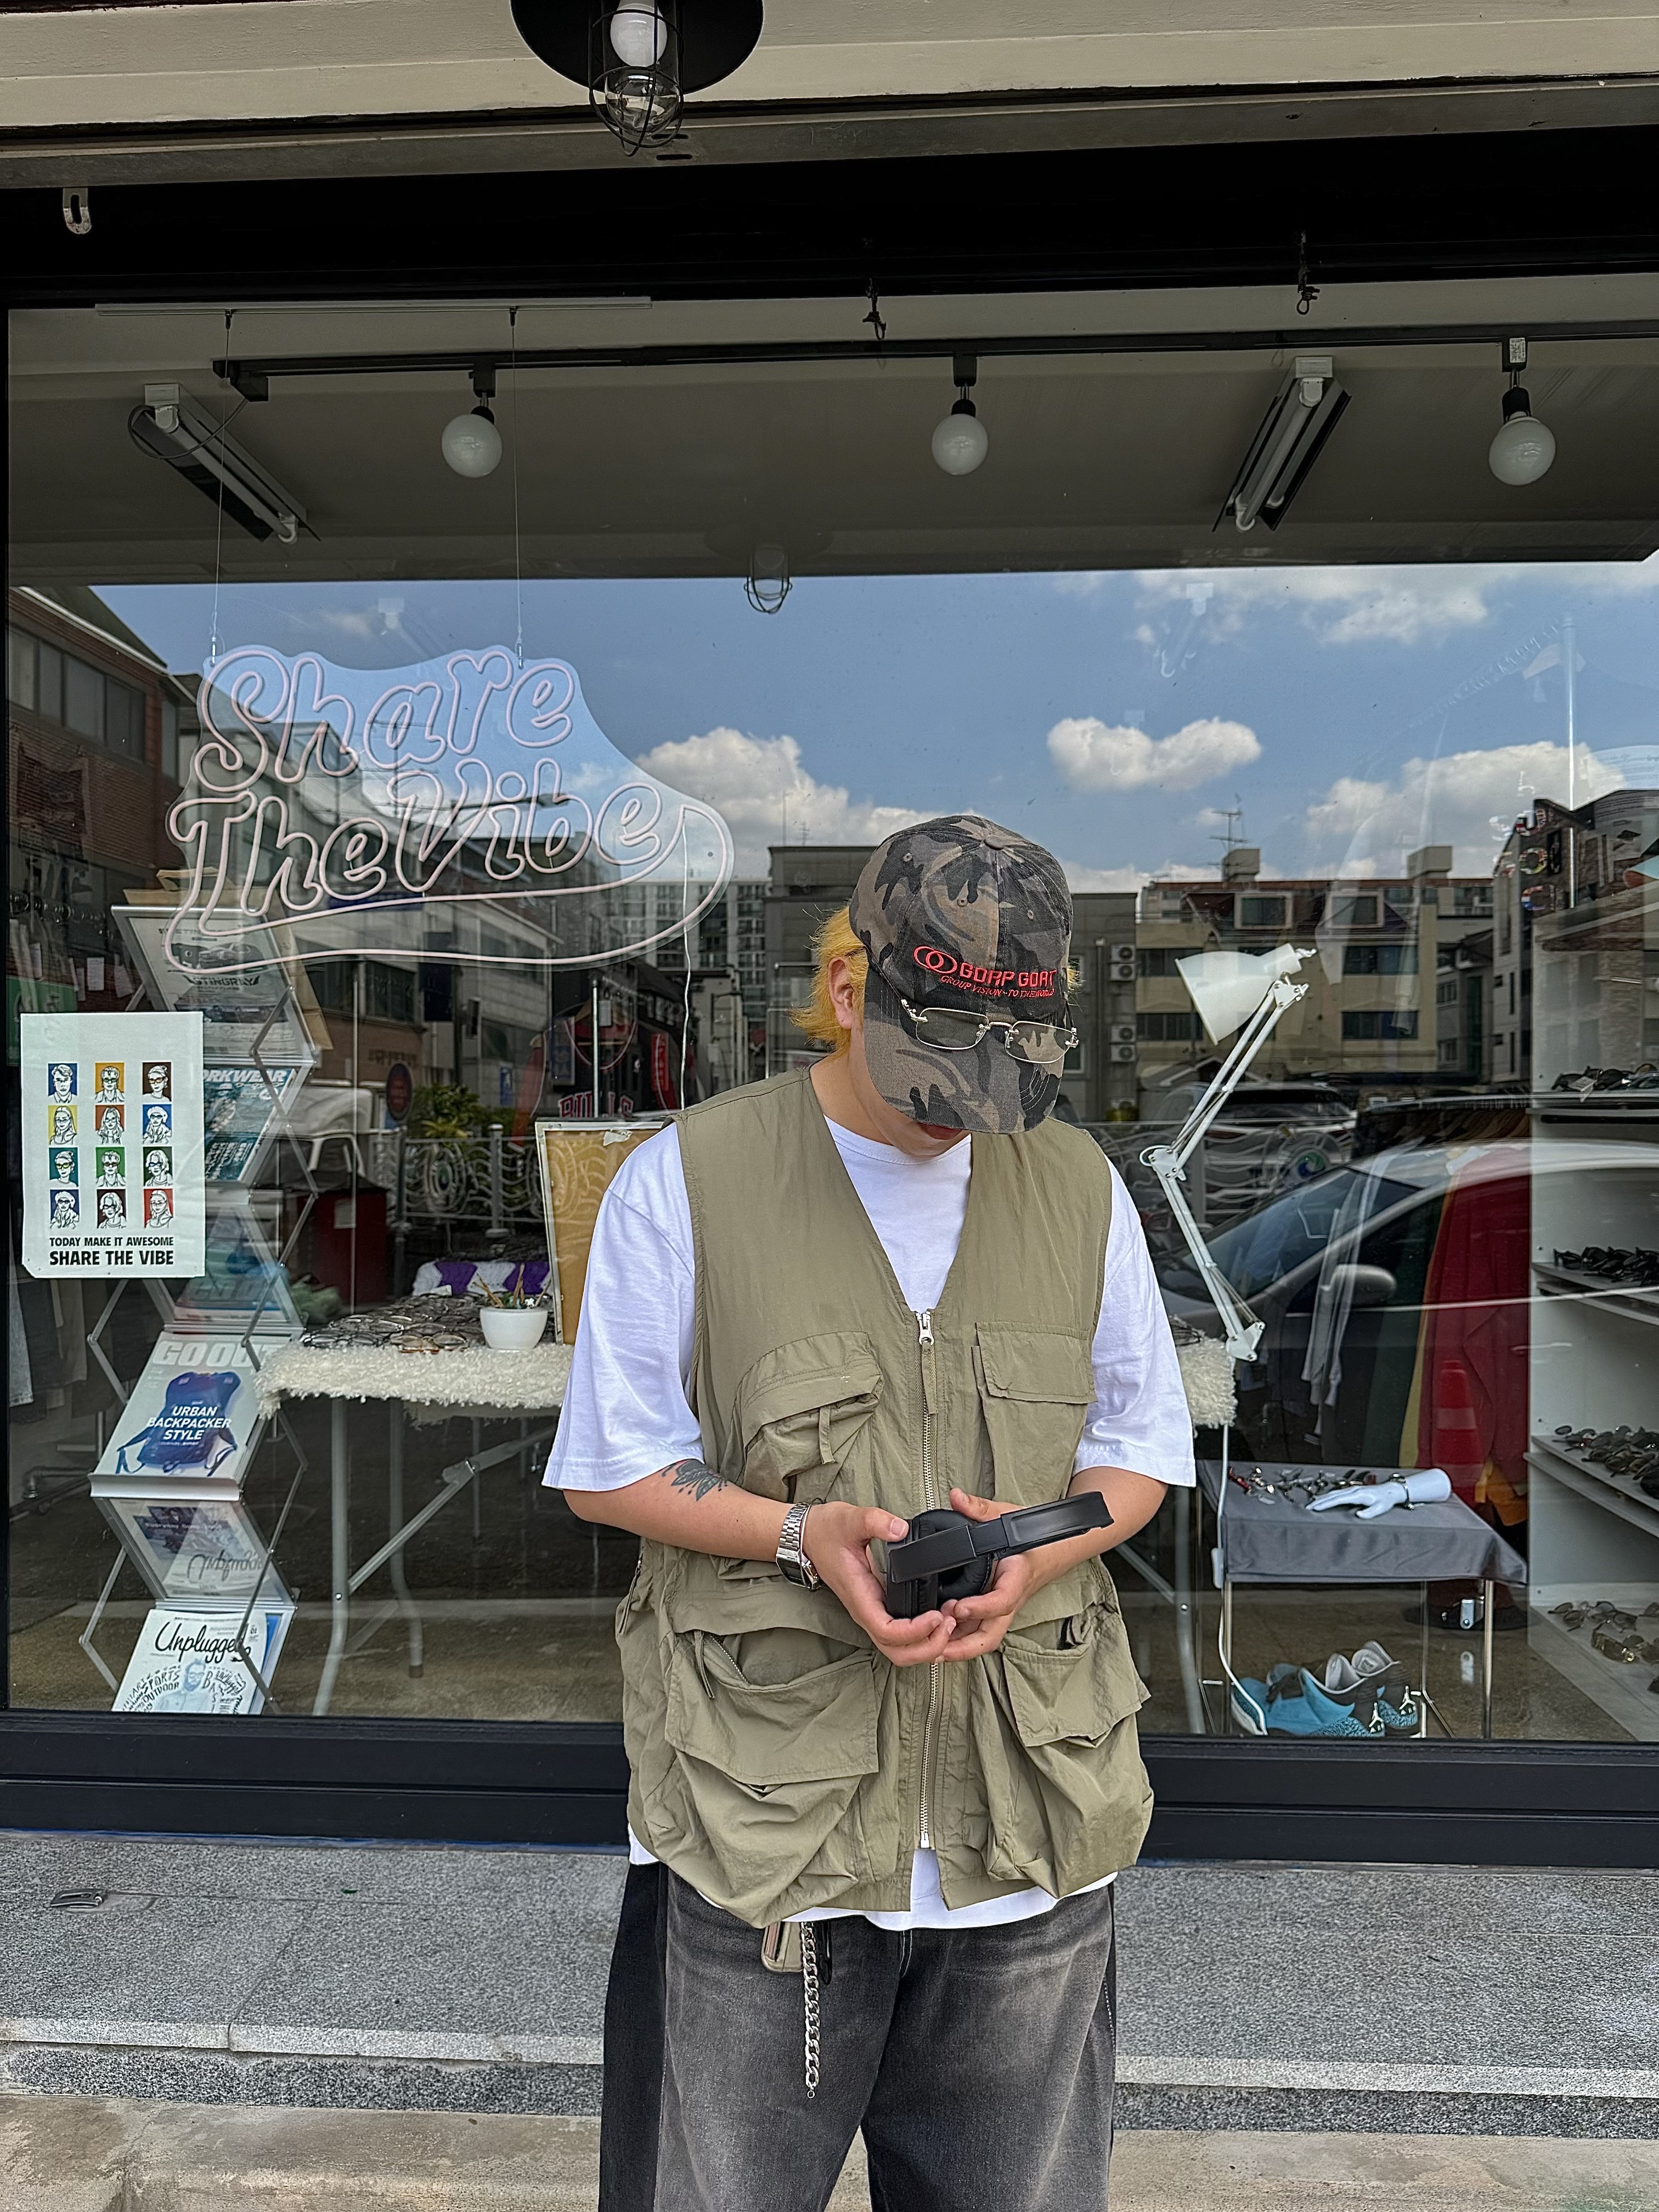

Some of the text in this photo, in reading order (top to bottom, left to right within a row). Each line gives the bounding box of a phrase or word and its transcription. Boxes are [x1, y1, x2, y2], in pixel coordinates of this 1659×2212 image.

[194, 648, 574, 793] Share
[193, 975, 254, 986] STINGRAY
[959, 962, 1058, 988] GORP GOAT
[940, 975, 972, 990] GROUP
[1008, 989, 1019, 997] TO
[49, 1237, 174, 1246] TODAY MAKE IT AWESOME
[49, 1250, 173, 1266] SHARE THE VIBE
[172, 1406, 218, 1417] URBAN
[147, 1417, 232, 1429] BACKPACKER
[163, 1429, 205, 1440] STYLE
[155, 1621, 251, 1664] Unplugge
